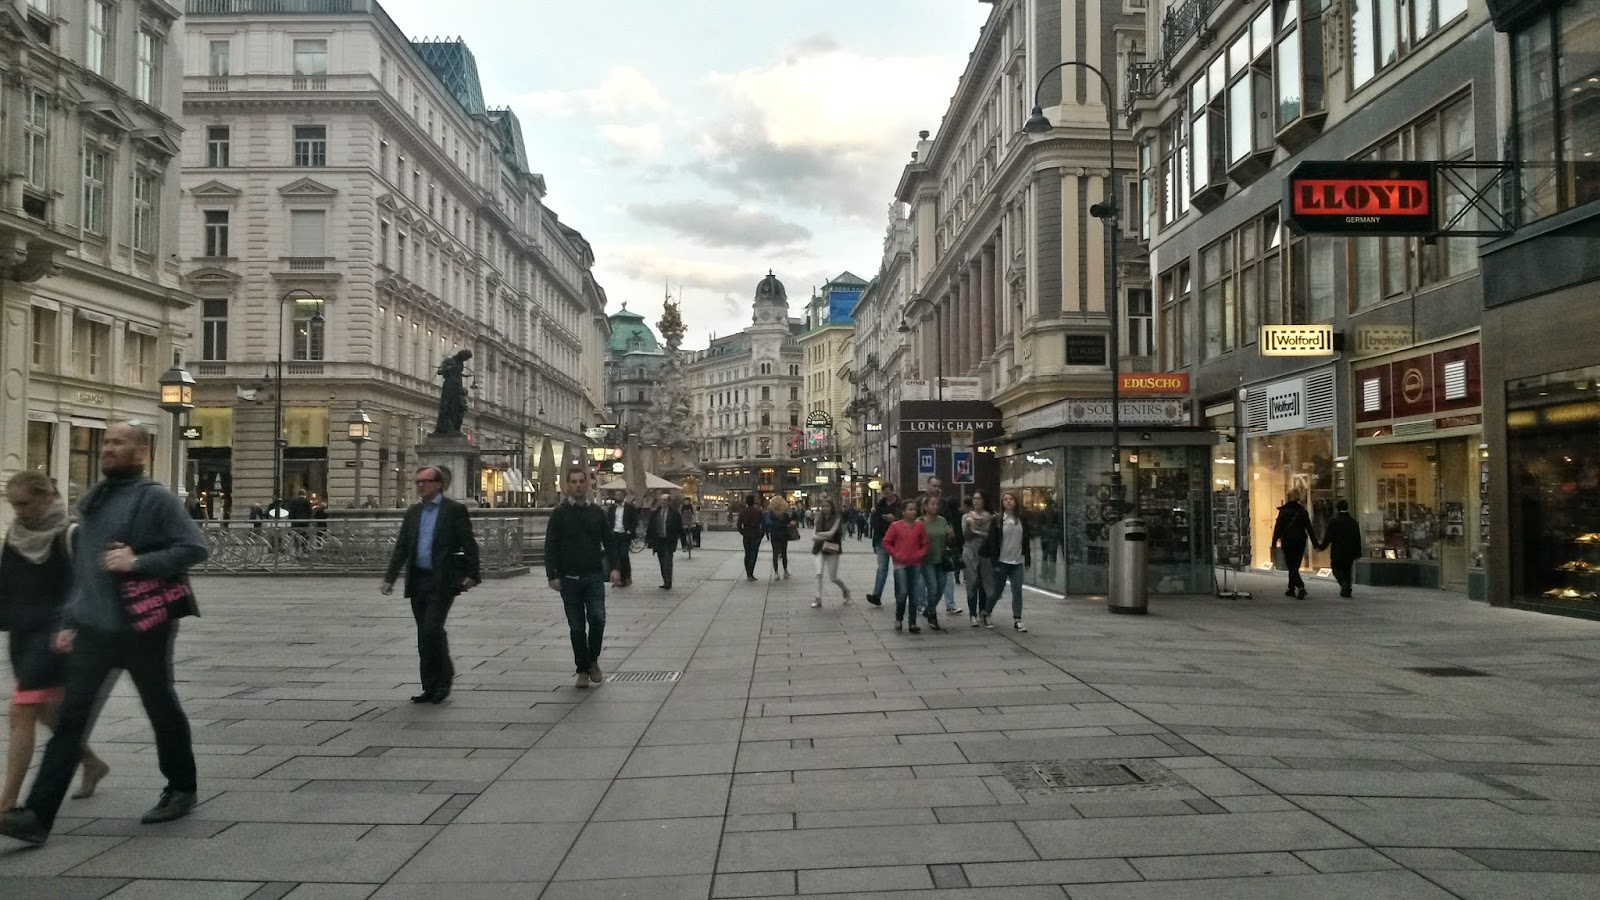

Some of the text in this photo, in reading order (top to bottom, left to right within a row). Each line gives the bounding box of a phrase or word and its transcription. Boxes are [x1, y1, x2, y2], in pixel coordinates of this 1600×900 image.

[1301, 184, 1423, 209] LLOYD
[1345, 216, 1381, 224] GERMANY
[1275, 335, 1320, 346] Wolford
[1123, 377, 1181, 389] EDUSCHO
[1273, 398, 1295, 413] Wolford
[910, 421, 994, 431] LONGCHAMP
